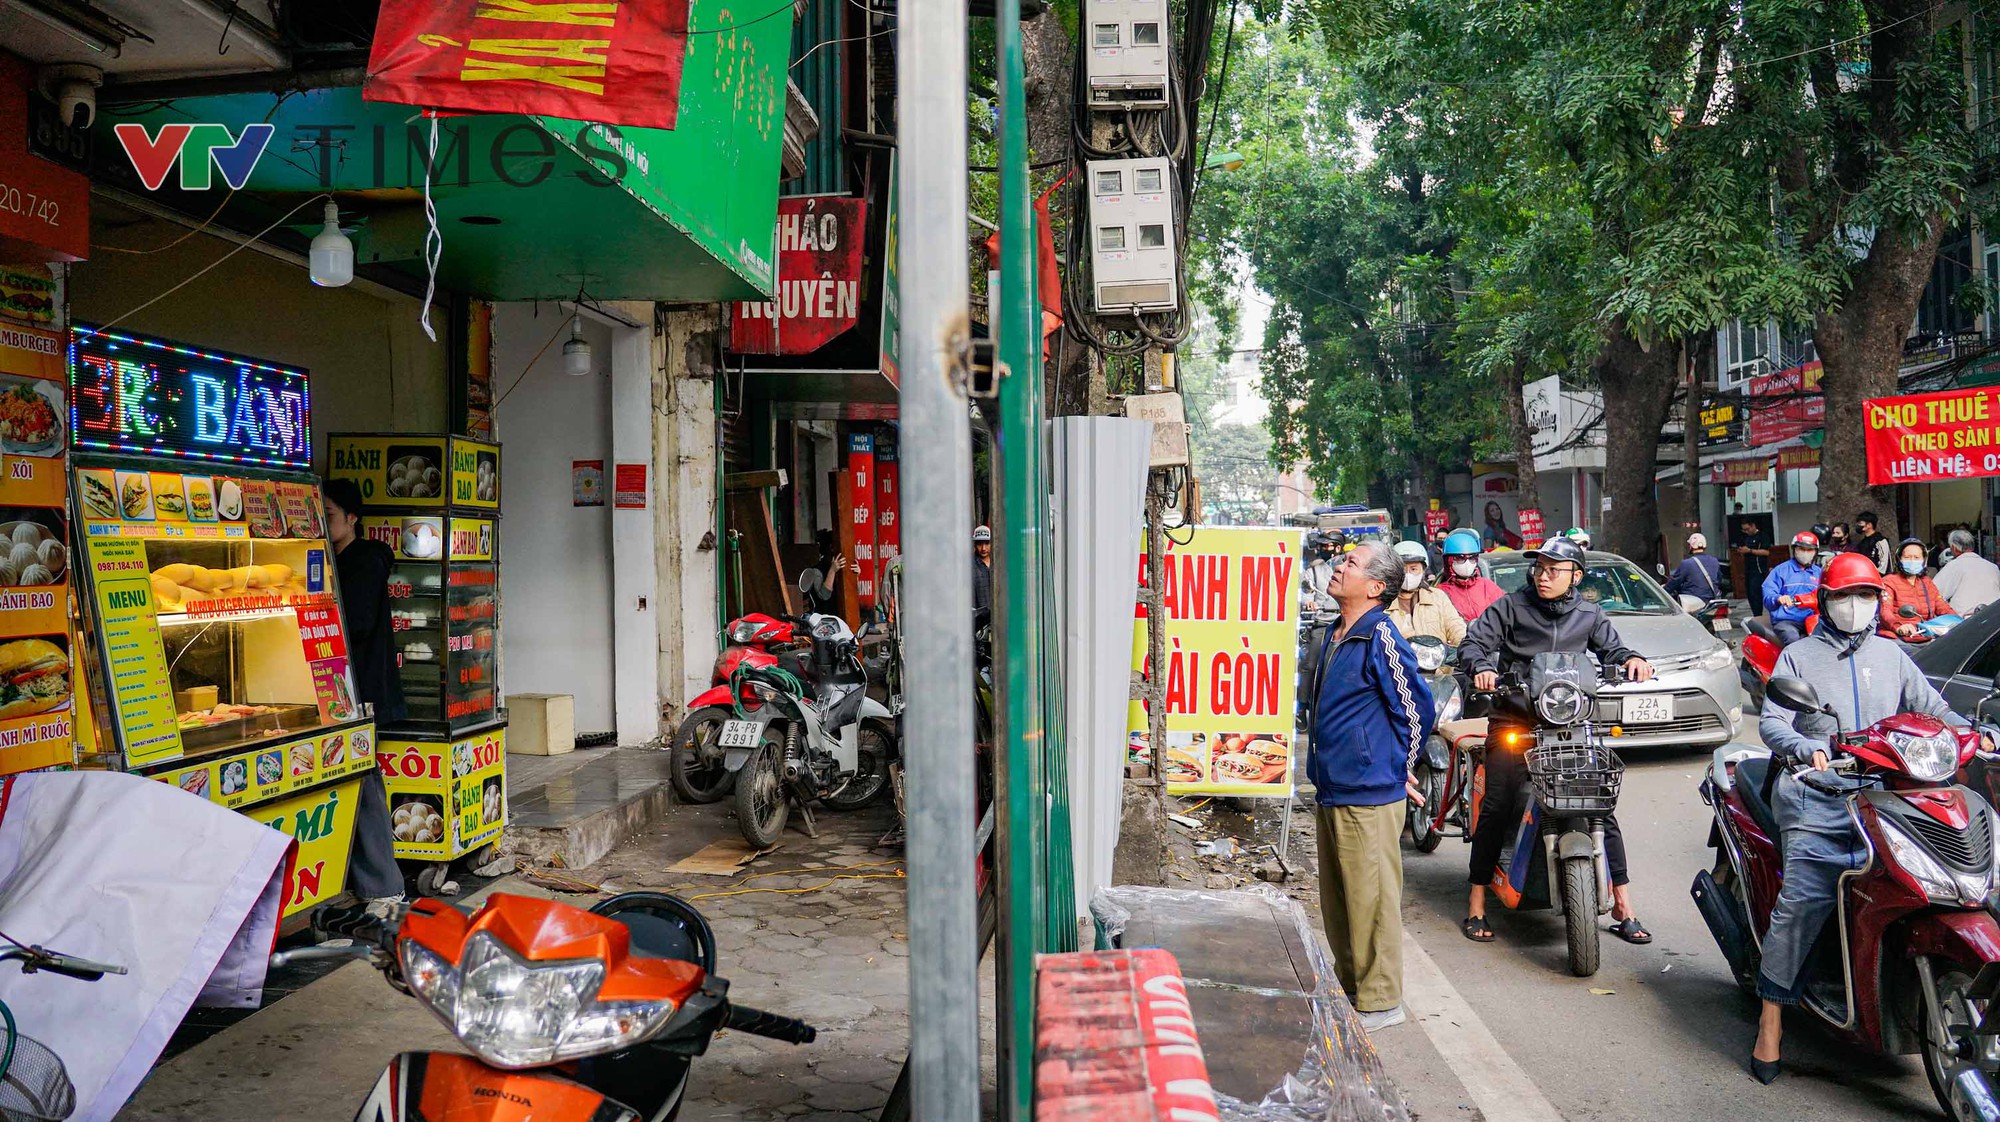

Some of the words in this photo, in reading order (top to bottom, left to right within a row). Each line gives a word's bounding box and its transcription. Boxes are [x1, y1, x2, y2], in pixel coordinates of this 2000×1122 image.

[778, 199, 838, 251] HẢO
[0, 331, 57, 354] MBURGER
[1870, 403, 1917, 430] CHO
[1926, 391, 1990, 425] THUÊ
[852, 443, 870, 451] THẤT
[854, 435, 868, 444] NỘI
[1900, 431, 1948, 455] (THEO
[1953, 426, 1990, 448] SÀN
[334, 443, 382, 470] BÁNH
[454, 447, 475, 473] BÁNH
[1891, 456, 1931, 478] LIÊN
[1938, 454, 1971, 476] HỆ:
[1984, 454, 2000, 471] 0
[11, 460, 33, 479] XÔI
[856, 465, 866, 488] TỦ
[457, 479, 472, 500] BAO
[882, 473, 892, 494] TỦ
[853, 503, 869, 524] BẾP
[881, 507, 895, 526] BẾP
[453, 524, 467, 555] BÁNH
[97, 560, 144, 571] 0987.184.110
[858, 580, 872, 596] INH
[1239, 542, 1293, 622] MỲ
[31, 593, 54, 608] BAO
[107, 590, 147, 609] MENU
[392, 616, 412, 633] ỆT
[315, 641, 334, 659] 10K
[1142, 637, 1199, 714] ÀI
[1210, 636, 1280, 716] GÒN
[1638, 698, 1659, 709] 22A
[1630, 709, 1668, 721] 125.43
[22, 722, 37, 743] MÌ
[40, 718, 71, 741] RUỐC
[728, 722, 757, 733] 34-P8
[725, 734, 754, 745] 2991
[377, 746, 442, 779] XÔI
[472, 737, 500, 770] XÔI
[462, 783, 480, 808] BÁNH
[464, 811, 478, 834] BAO
[1852, 886, 1873, 903] HONDA
[474, 1087, 532, 1107] HONDA
